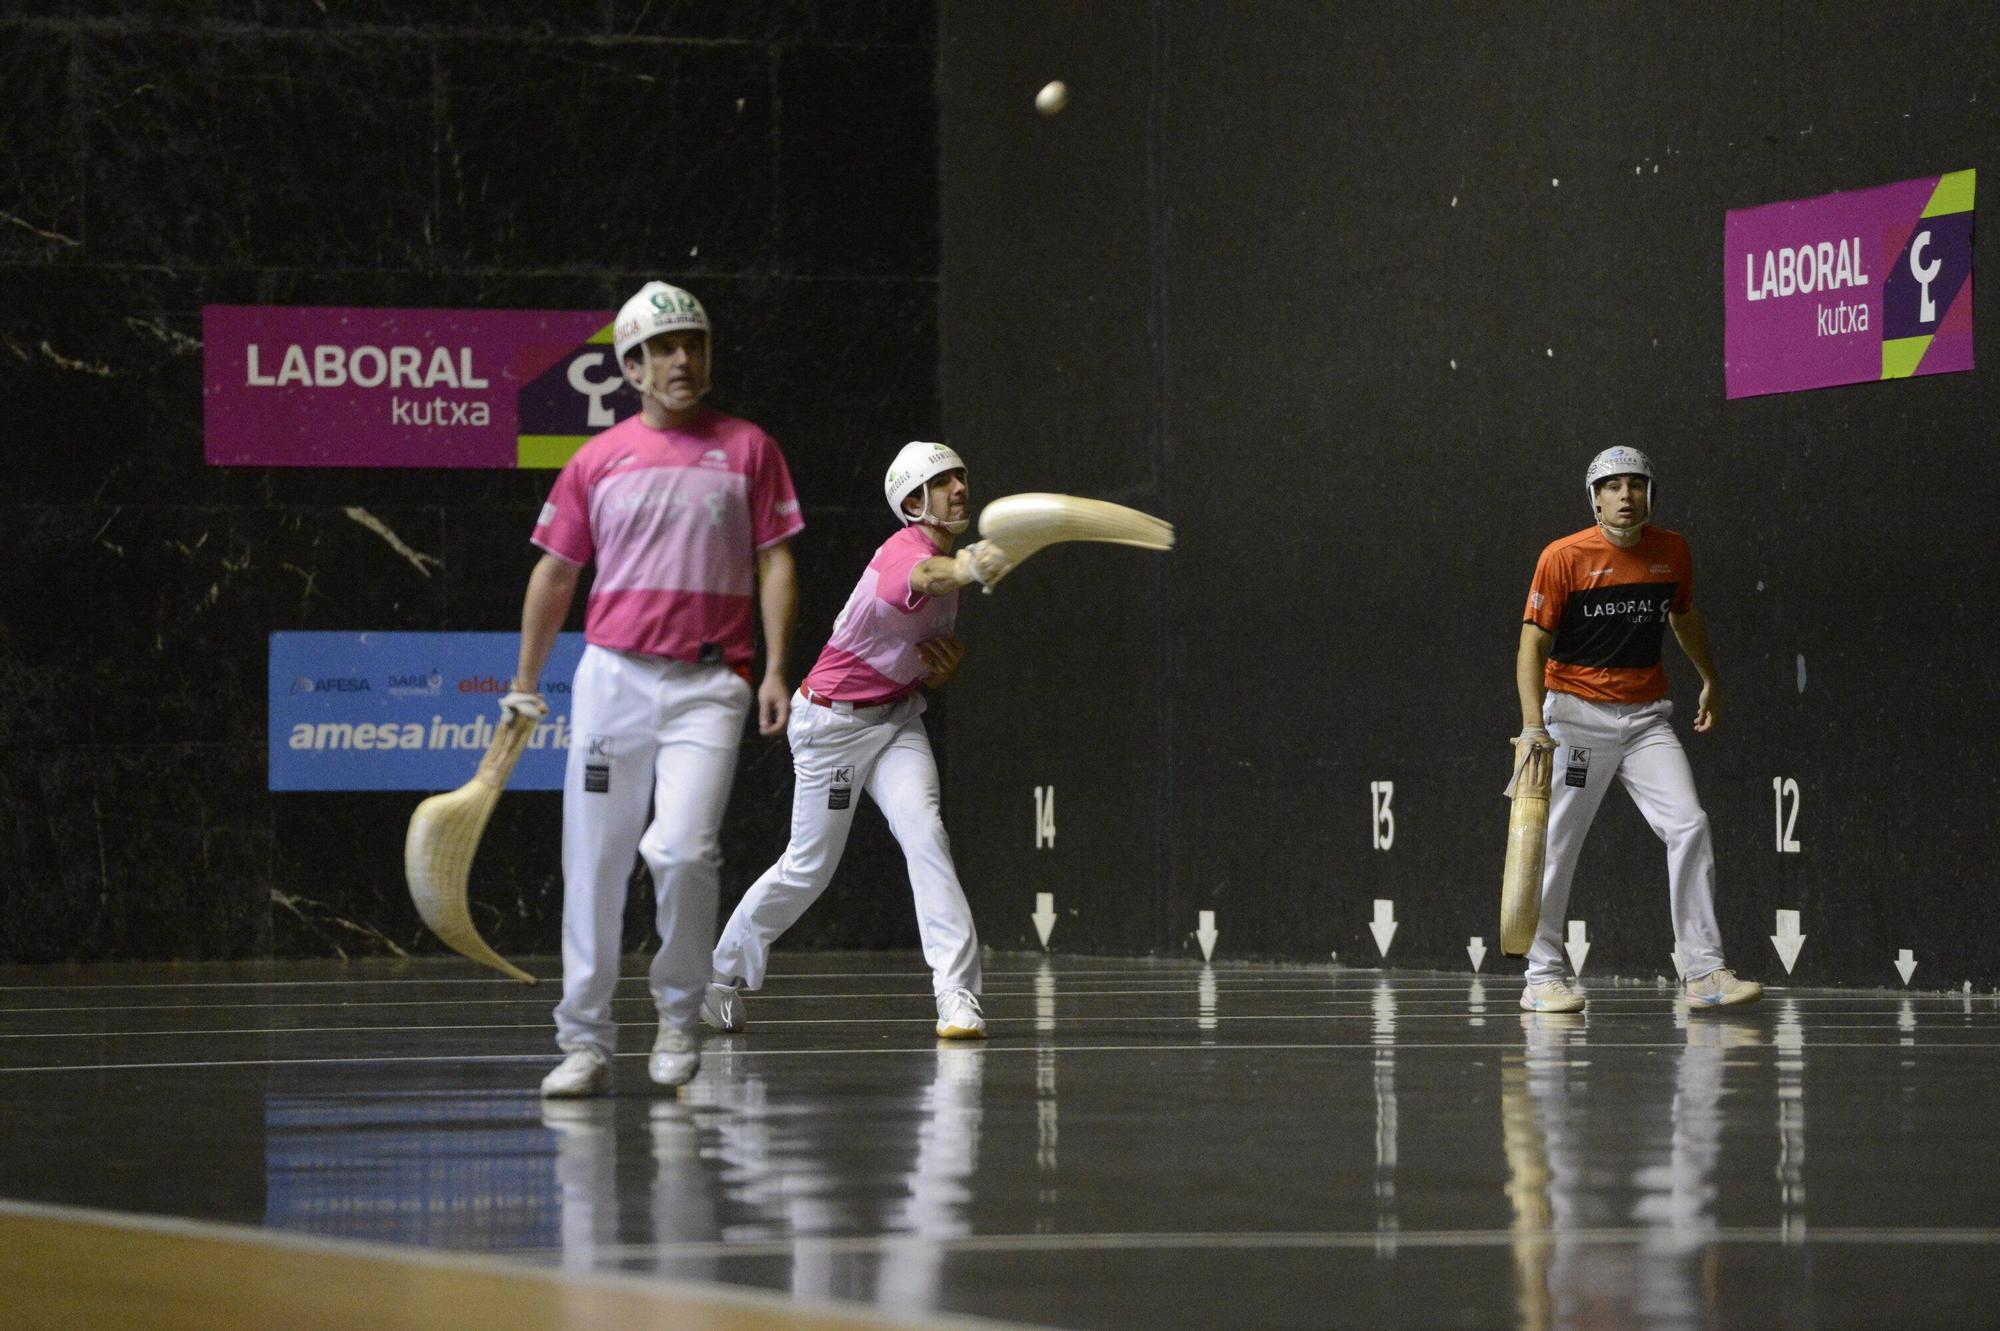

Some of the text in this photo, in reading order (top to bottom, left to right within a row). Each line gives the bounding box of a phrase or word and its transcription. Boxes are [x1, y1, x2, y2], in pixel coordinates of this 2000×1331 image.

[1747, 237, 1868, 301] LABORAL
[1817, 301, 1869, 337] kutxa
[246, 344, 489, 389] LABORAL
[392, 396, 490, 426] kutxa
[1584, 600, 1654, 617] LABORAL
[458, 676, 510, 693] eldu
[289, 722, 426, 751] amesa
[1034, 784, 1056, 849] 14
[1370, 780, 1395, 851] 13
[1773, 776, 1801, 852] 12
